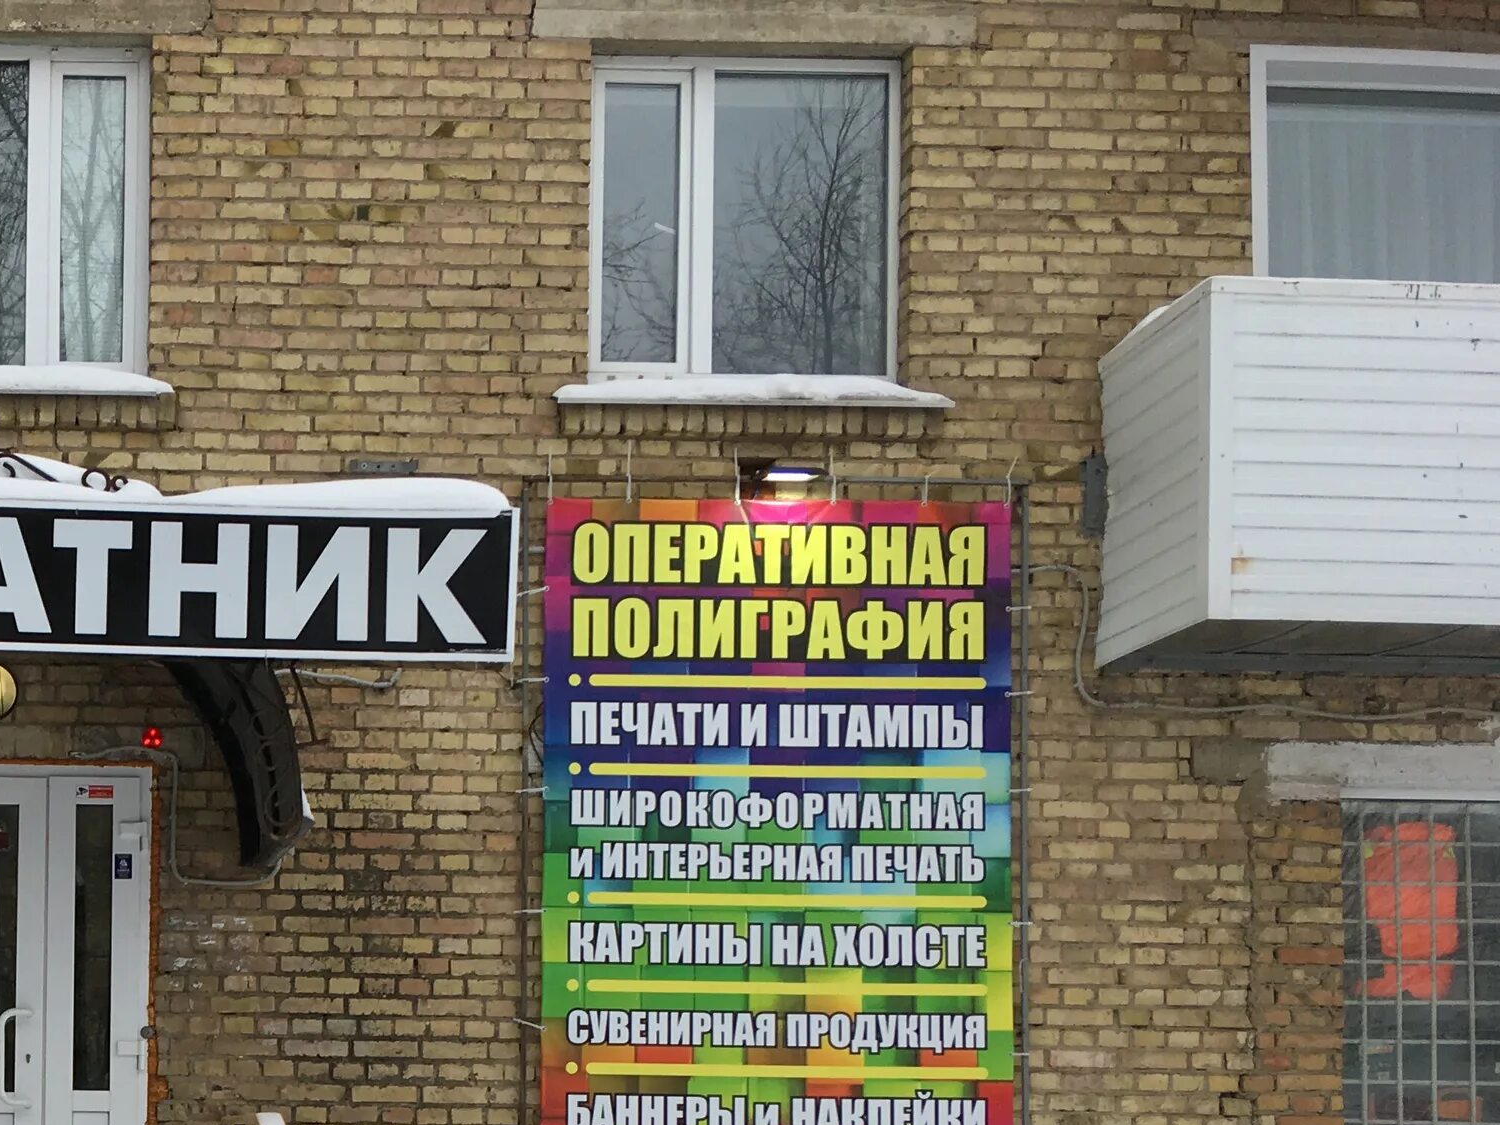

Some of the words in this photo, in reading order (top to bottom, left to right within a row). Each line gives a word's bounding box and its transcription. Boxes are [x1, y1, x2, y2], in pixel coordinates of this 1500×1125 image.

[573, 522, 985, 586] ОПЕРАТИВНАЯ
[572, 598, 985, 660] ПОЛИГРАФИЯ
[570, 702, 729, 747] ПЕЧАТИ
[740, 704, 767, 746] И
[779, 705, 984, 748] ШТАМПЫ
[570, 790, 983, 831] ШИРОКОФОРМАТНАЯ
[602, 842, 841, 880] ИНТЕРЬЕРНАЯ
[851, 845, 985, 882] ПЕЧАТЬ
[569, 922, 761, 965] КАРТИНЫ
[772, 925, 826, 965] НА
[833, 926, 985, 967] ХОЛСТЕ
[567, 1010, 776, 1047] СУВЕНИРНАЯ
[786, 1014, 986, 1053] ПРОДУКЦИЯ
